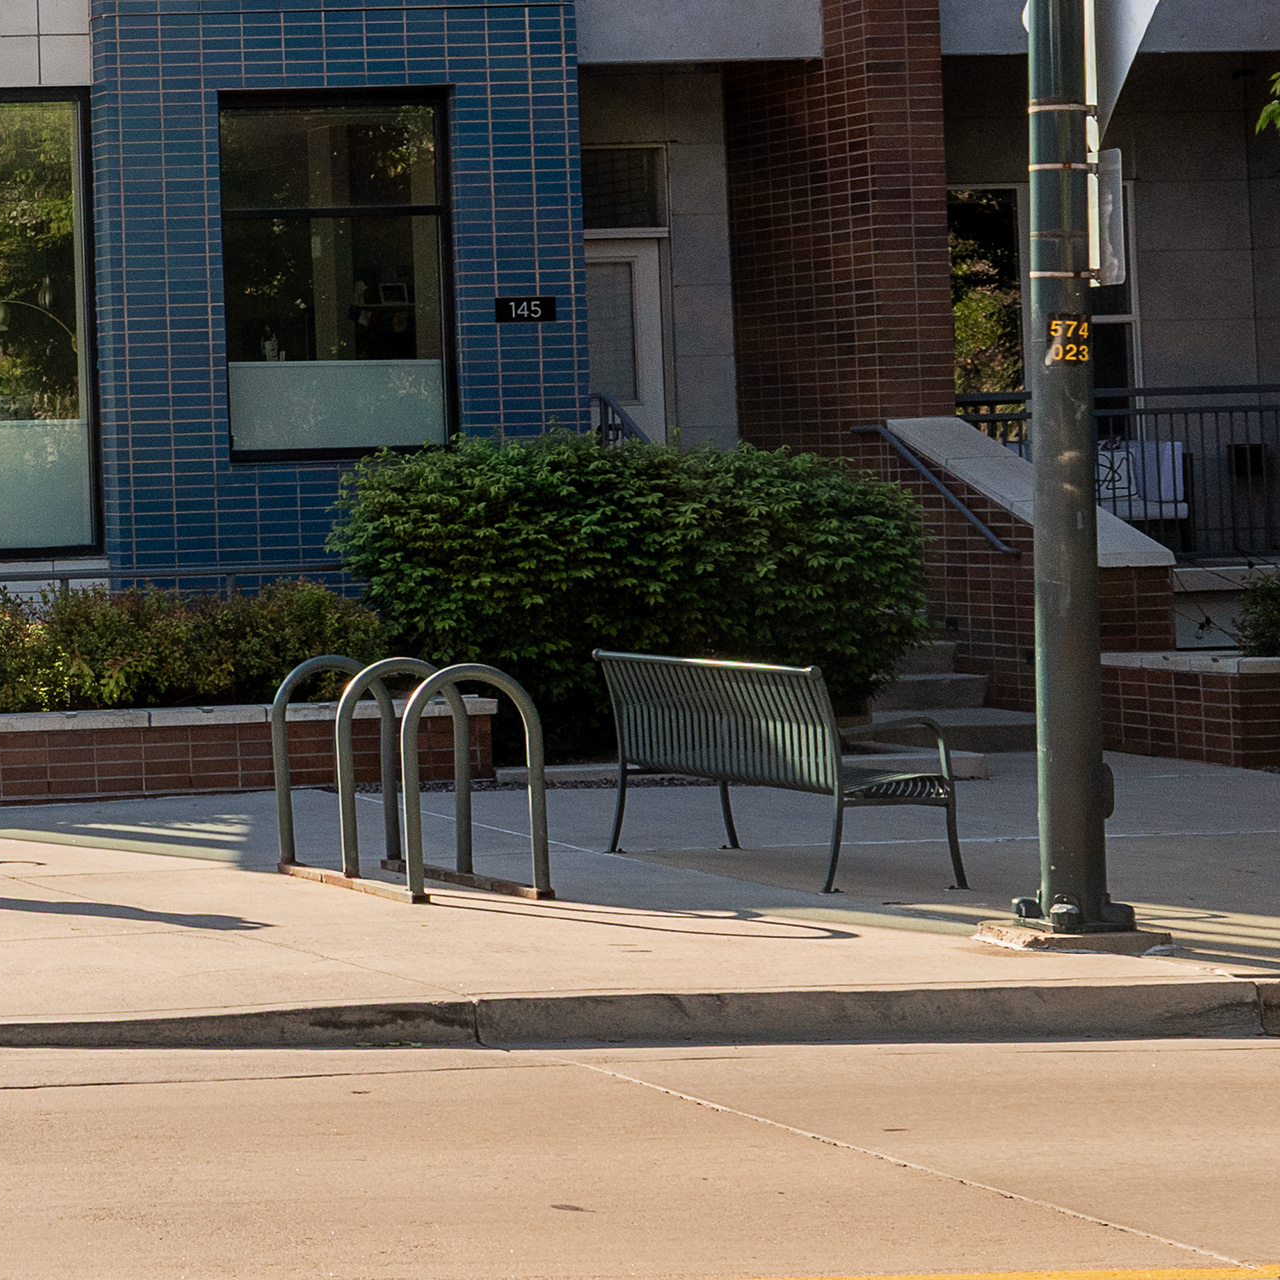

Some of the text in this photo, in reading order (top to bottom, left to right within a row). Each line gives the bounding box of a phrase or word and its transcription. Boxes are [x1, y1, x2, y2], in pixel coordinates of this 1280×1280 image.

[509, 301, 542, 318] 145
[1049, 320, 1089, 339] 574
[1051, 344, 1089, 361] 023
